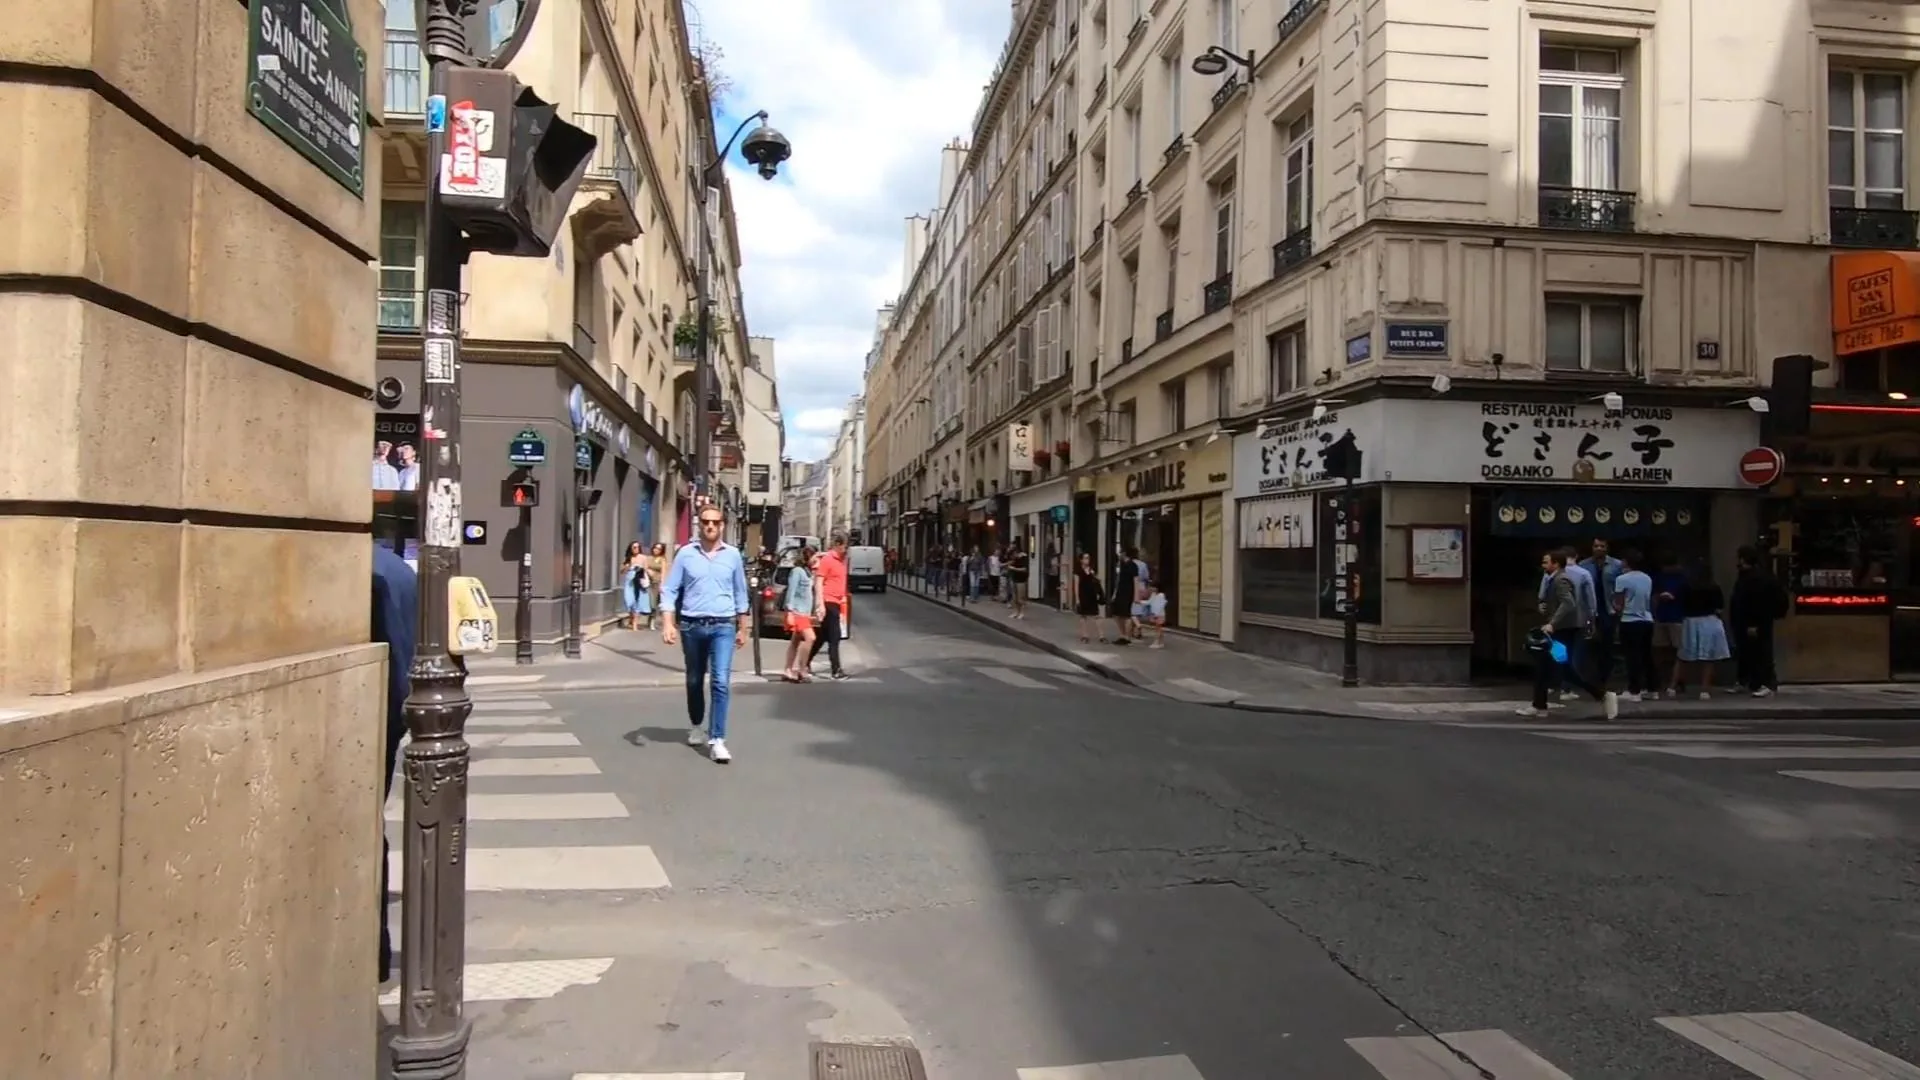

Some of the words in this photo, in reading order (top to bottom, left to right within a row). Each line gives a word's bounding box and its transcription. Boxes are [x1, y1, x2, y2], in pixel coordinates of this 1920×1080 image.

[300, 2, 329, 58] RUE
[261, 5, 360, 123] SAINTE-ANNE
[1400, 330, 1417, 338] RUE
[1418, 330, 1434, 338] DES
[1389, 340, 1415, 348] PETITS
[1416, 340, 1445, 349] CHAMPS
[1700, 343, 1715, 356] 30
[1481, 403, 1576, 418] RESTAURANT
[1125, 461, 1186, 499] CAMILLE
[1481, 464, 1554, 478] DOSANKO
[1613, 467, 1673, 481] LARMEN
